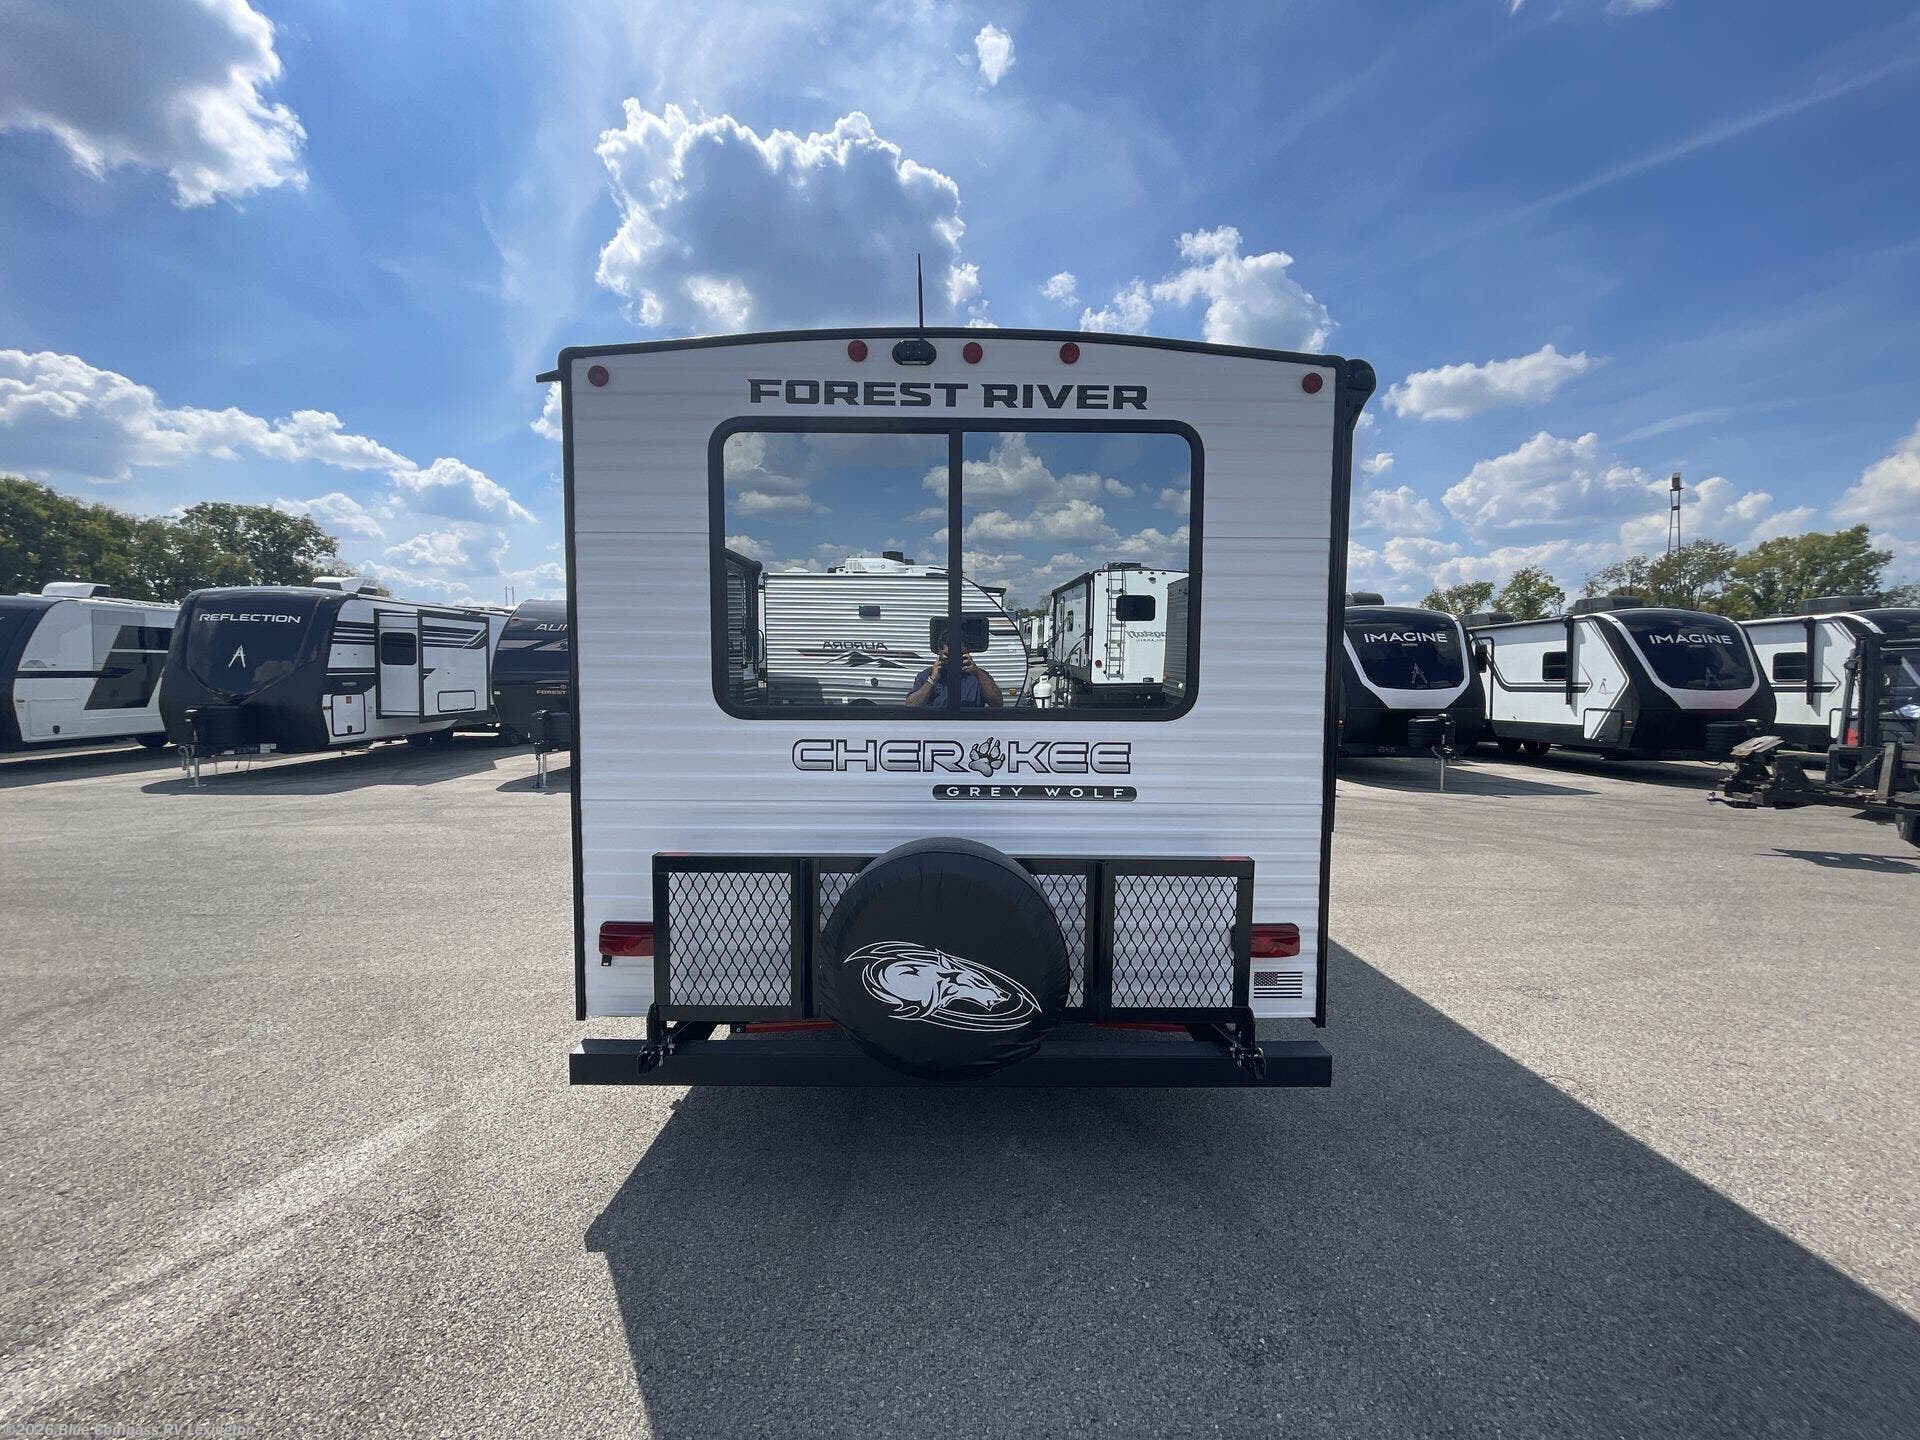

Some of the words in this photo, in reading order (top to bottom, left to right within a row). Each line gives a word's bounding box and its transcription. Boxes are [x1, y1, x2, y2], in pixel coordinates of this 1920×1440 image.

[748, 379, 969, 406] FOREST
[979, 383, 1148, 410] RIVER
[199, 613, 301, 624] REFLECTION
[1363, 632, 1448, 643] IMAGINE
[1648, 633, 1733, 645] IMAGINE
[946, 786, 1022, 798] GREY
[1045, 786, 1124, 799] WOLF
